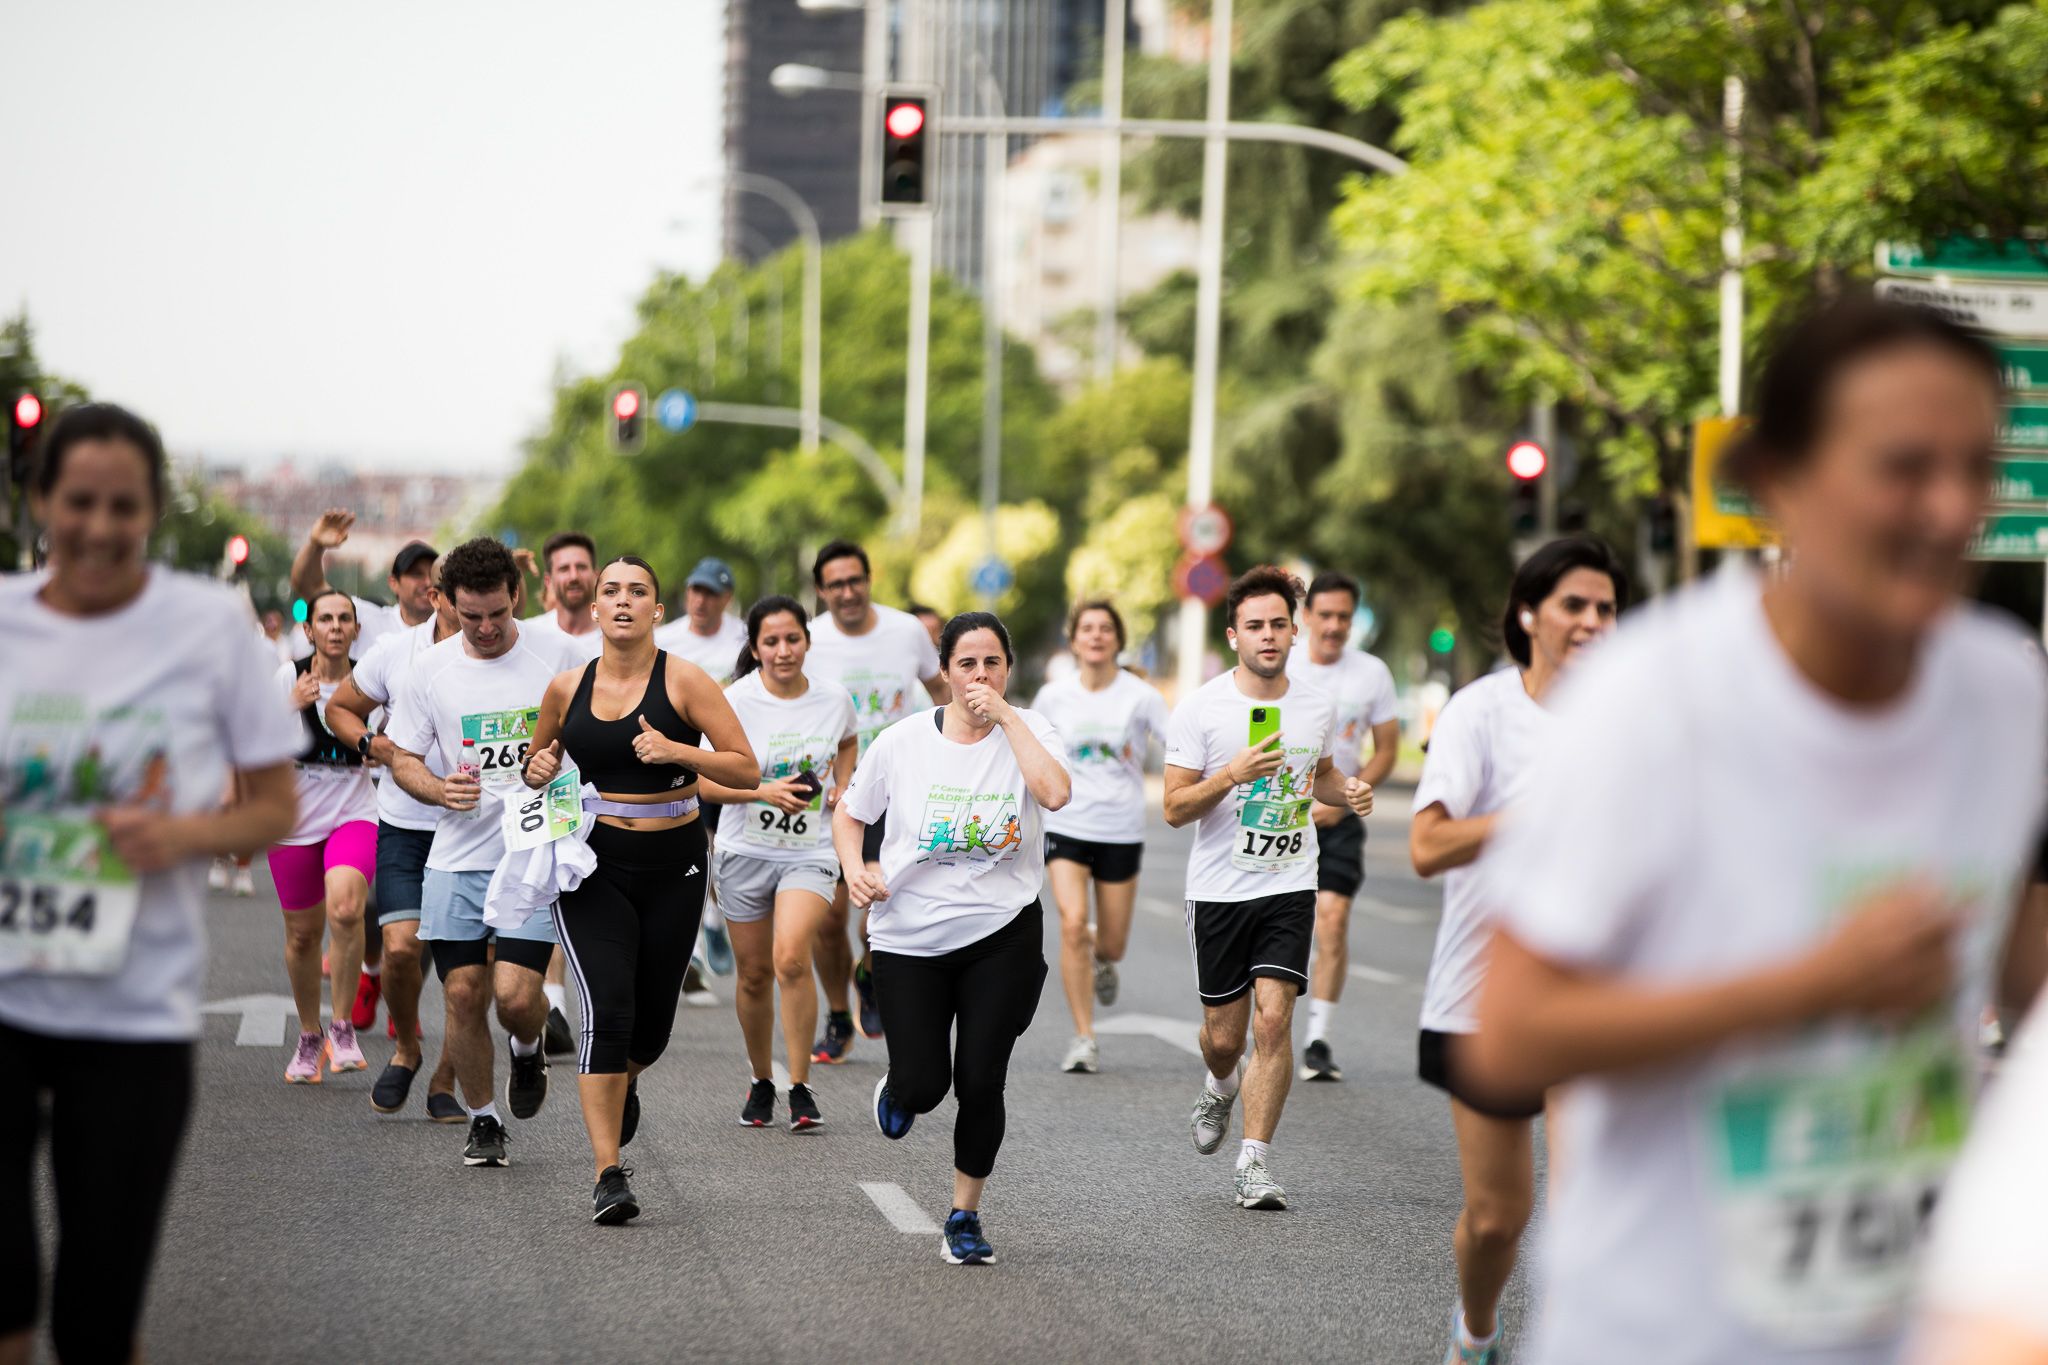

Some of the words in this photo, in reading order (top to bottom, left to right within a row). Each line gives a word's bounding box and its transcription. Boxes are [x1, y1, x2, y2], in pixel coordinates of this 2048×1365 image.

[480, 713, 528, 740] ELA
[928, 792, 973, 802] MADRID
[975, 794, 999, 802] CON
[1002, 792, 1016, 801] LA
[760, 810, 807, 835] 946
[1243, 831, 1303, 857] 1798
